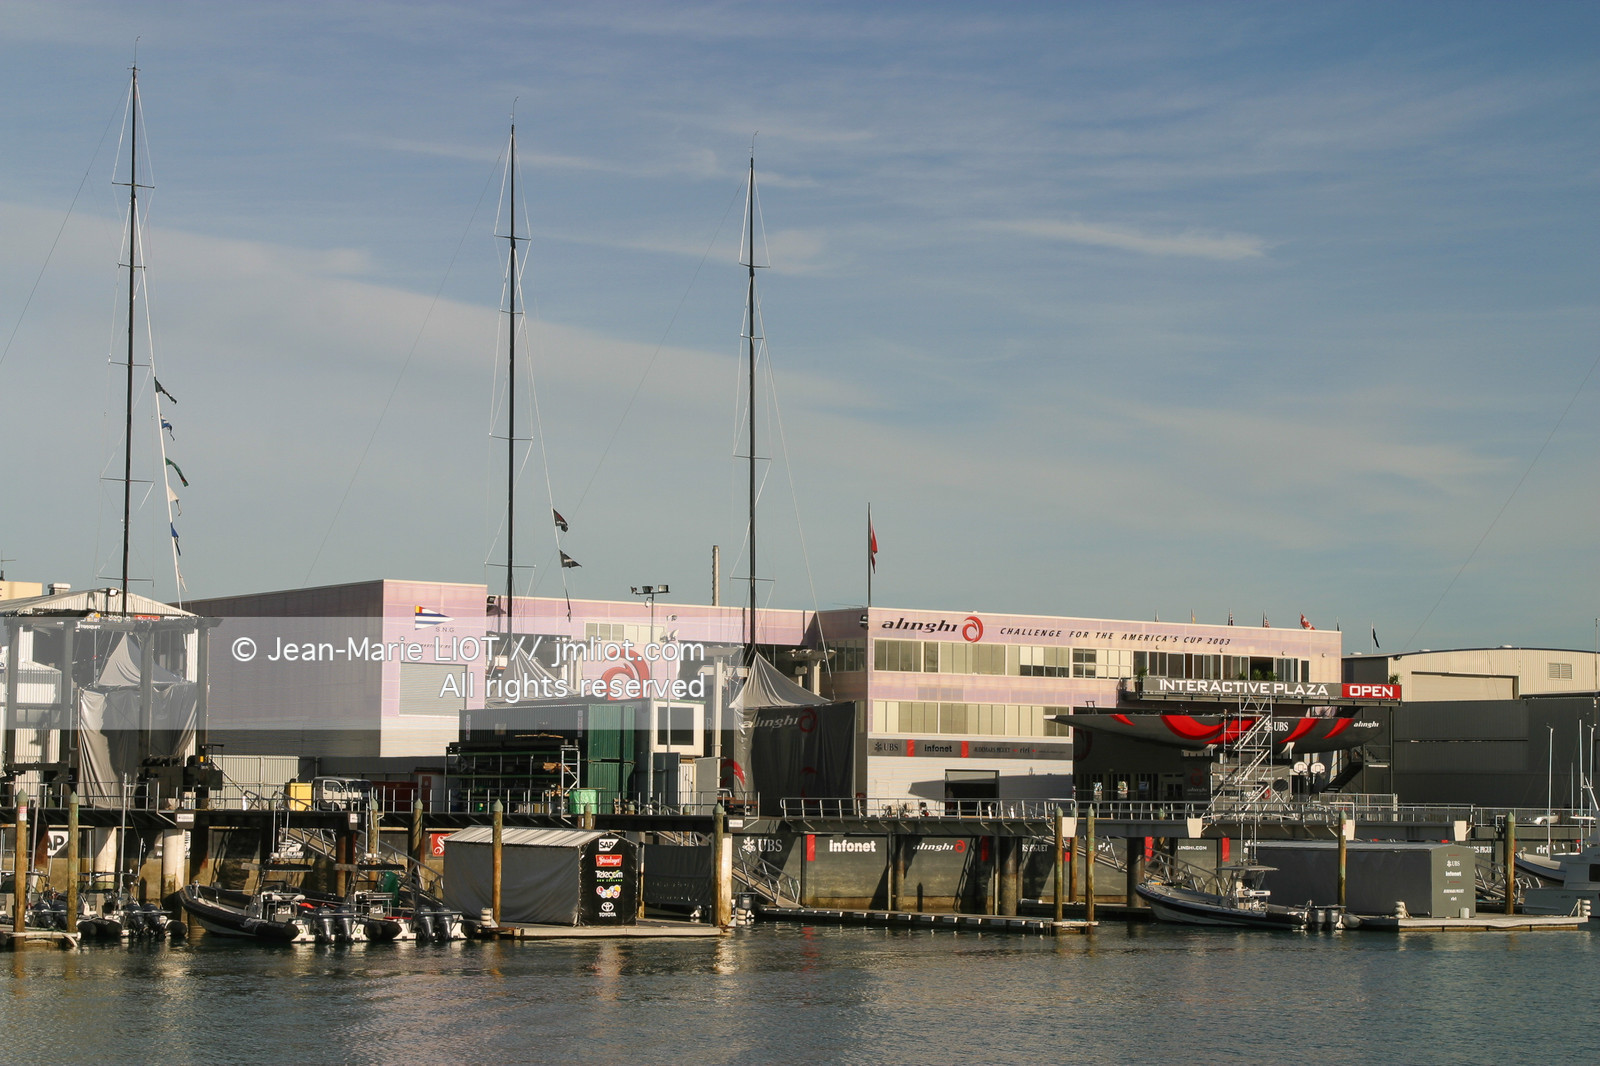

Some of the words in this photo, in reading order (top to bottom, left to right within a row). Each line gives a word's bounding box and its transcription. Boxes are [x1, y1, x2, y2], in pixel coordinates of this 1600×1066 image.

[881, 617, 958, 633] alinghi
[1000, 627, 1061, 638] CHALLENGE
[1069, 631, 1089, 639] FOR
[1095, 632, 1114, 640] THE
[1121, 633, 1179, 643] AMERICA'S
[1183, 636, 1203, 644] CUP
[1206, 637, 1231, 646] 2003
[1159, 679, 1270, 694] INTERACTIVE
[1274, 683, 1328, 696] PLAZA
[1349, 685, 1394, 697] OPEN
[1274, 722, 1288, 732] UBS
[883, 743, 898, 752] UBS
[924, 744, 952, 753] infonet
[599, 841, 614, 849] SAP
[758, 839, 782, 852] UBS
[829, 840, 876, 852] infonet
[595, 870, 624, 879] Telecom
